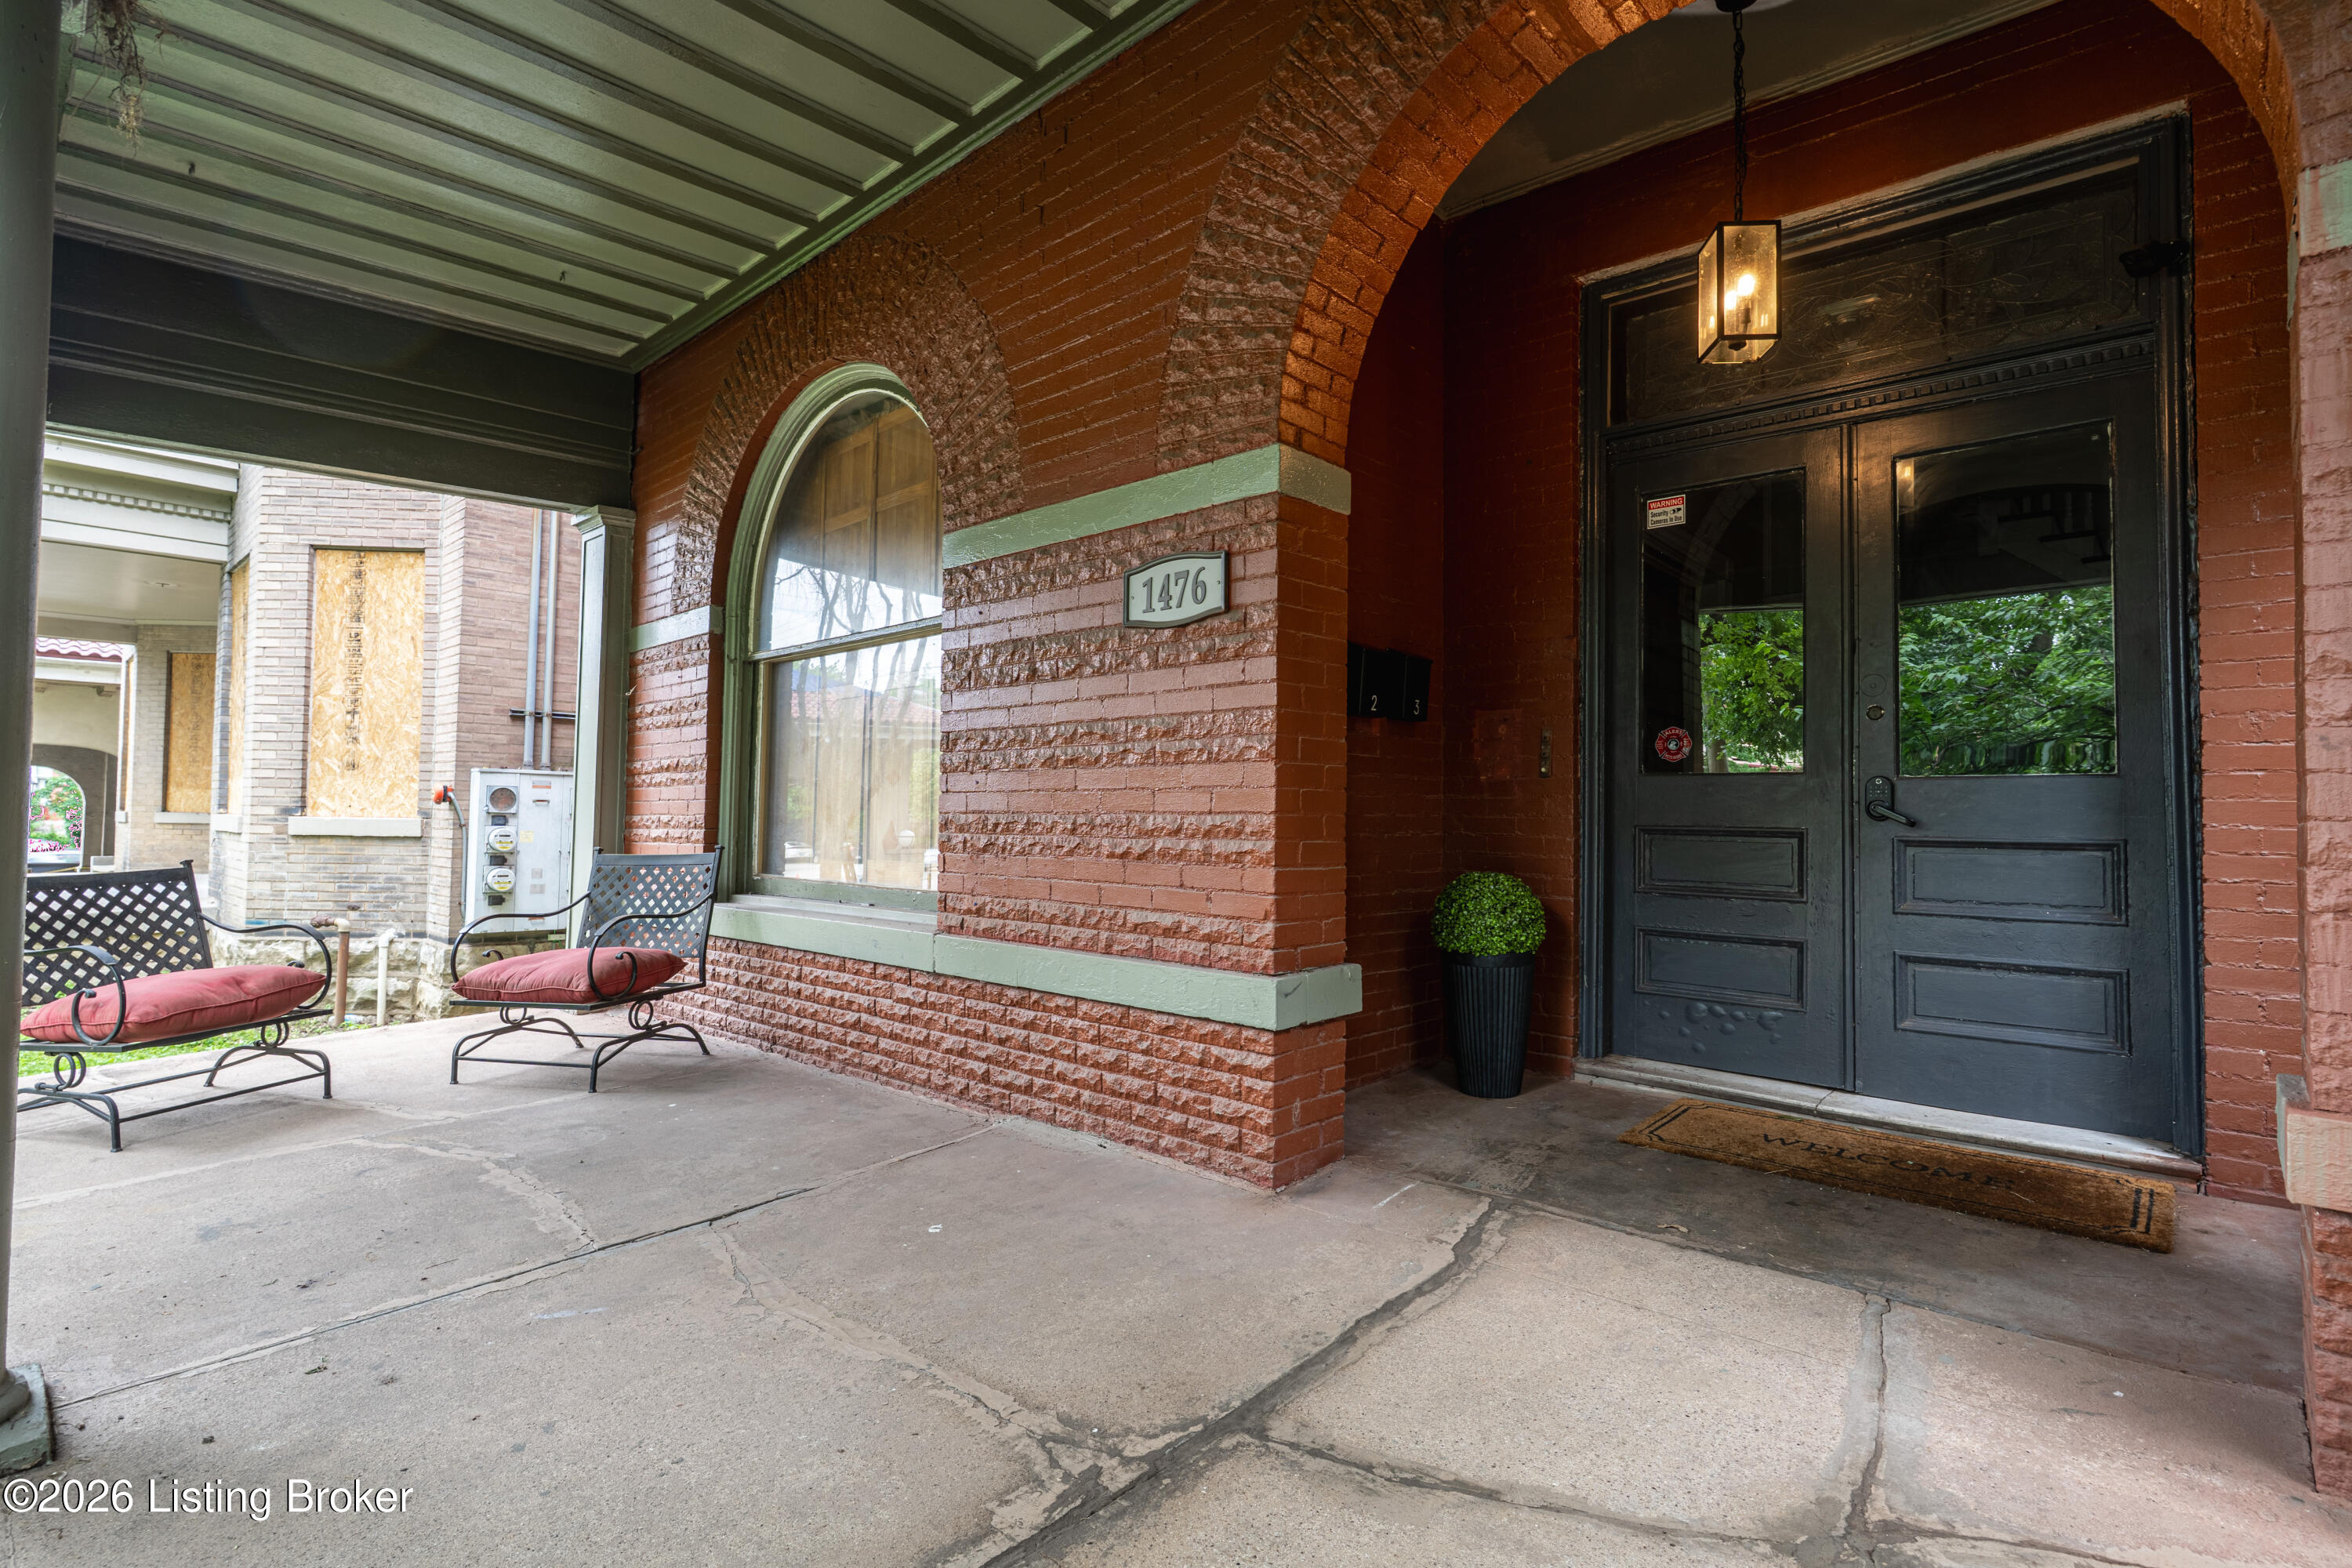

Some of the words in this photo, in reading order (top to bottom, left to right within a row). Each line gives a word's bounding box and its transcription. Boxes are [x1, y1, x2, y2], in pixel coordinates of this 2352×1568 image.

[1650, 498, 1682, 509] WARNING
[1650, 510, 1668, 518] Security
[1142, 566, 1206, 614] 1476
[1370, 695, 1377, 711] 2
[1414, 699, 1420, 715] 3
[1762, 1134, 2014, 1189] WELCOME
